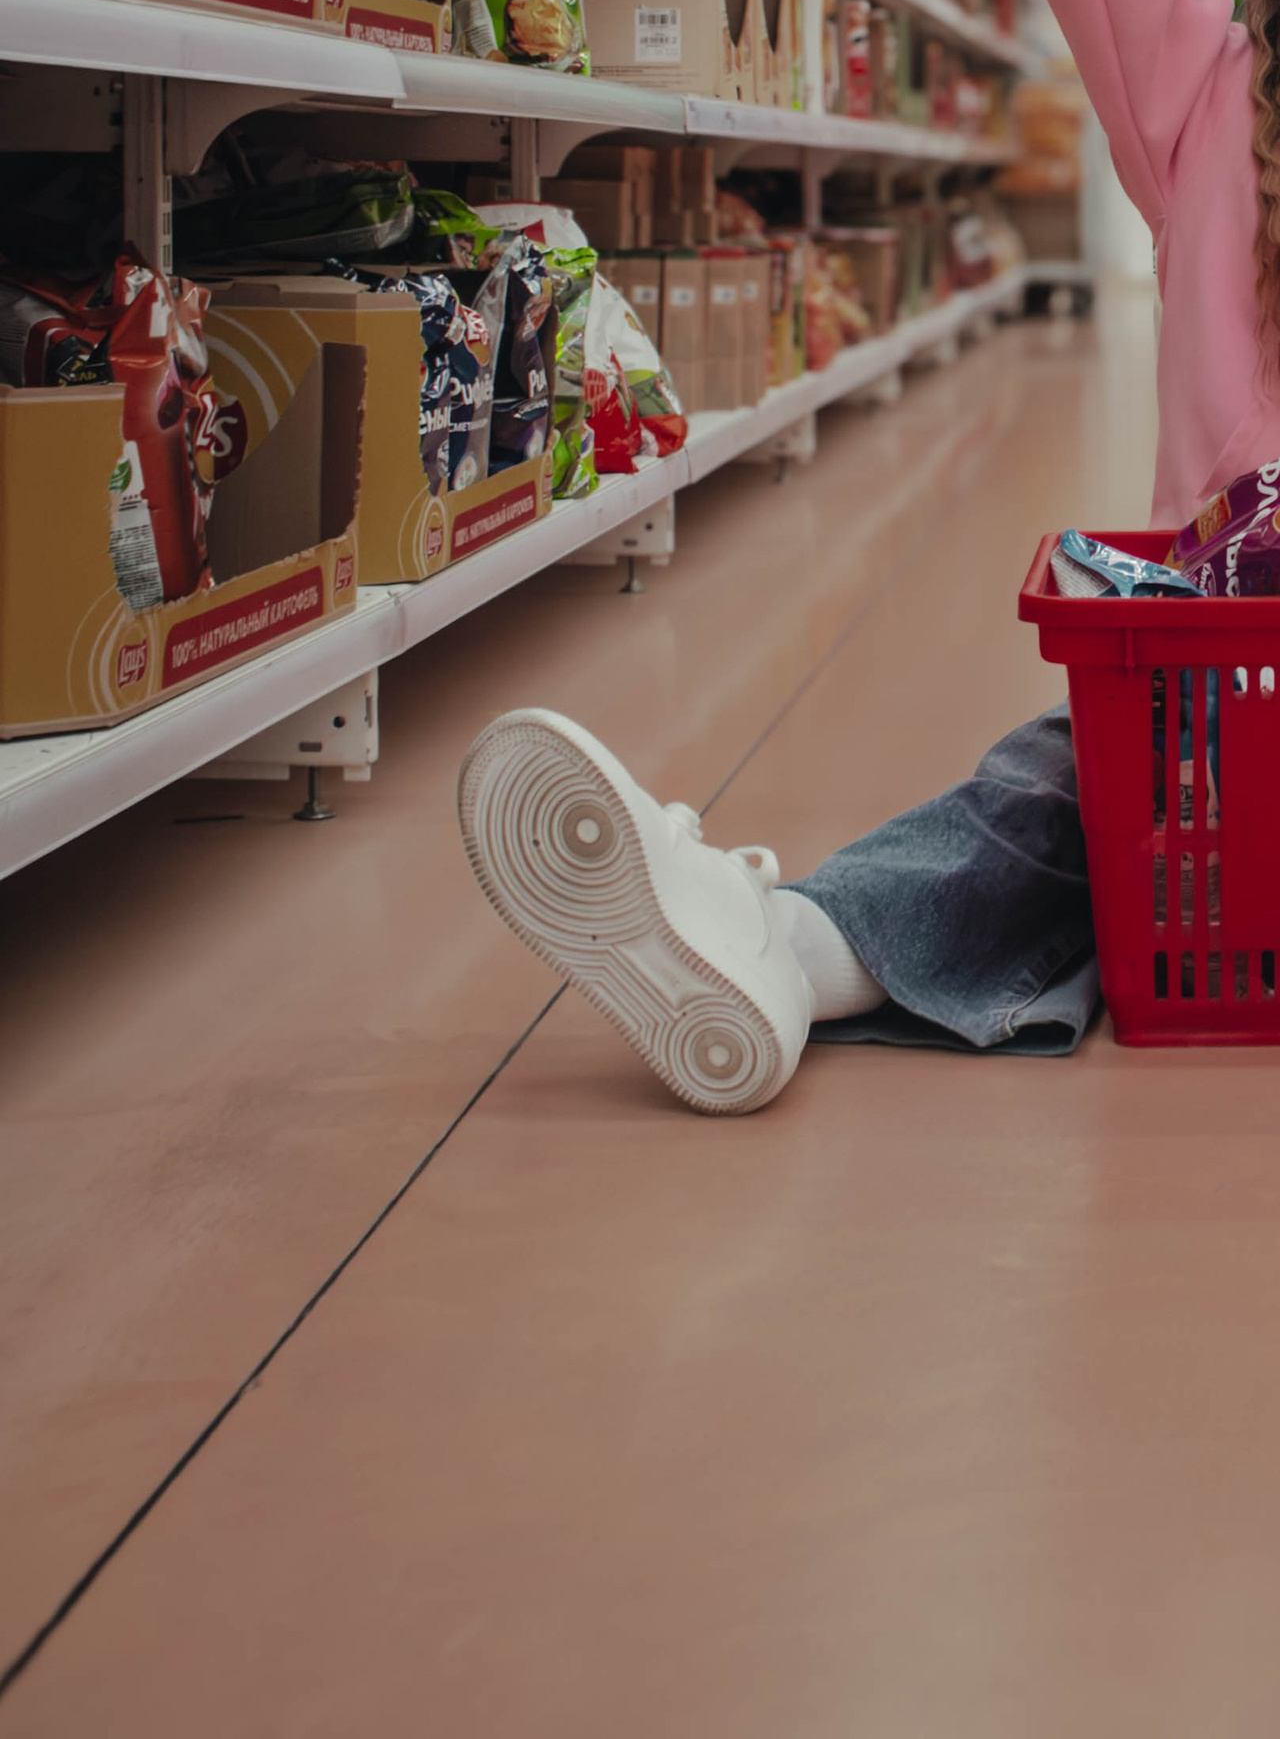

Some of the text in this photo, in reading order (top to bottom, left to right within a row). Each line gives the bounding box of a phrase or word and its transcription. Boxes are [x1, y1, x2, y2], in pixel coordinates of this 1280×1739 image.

[172, 585, 319, 669] 100% НАТУРАЛЬНЫЙ КАРТОФЕЛЬ
